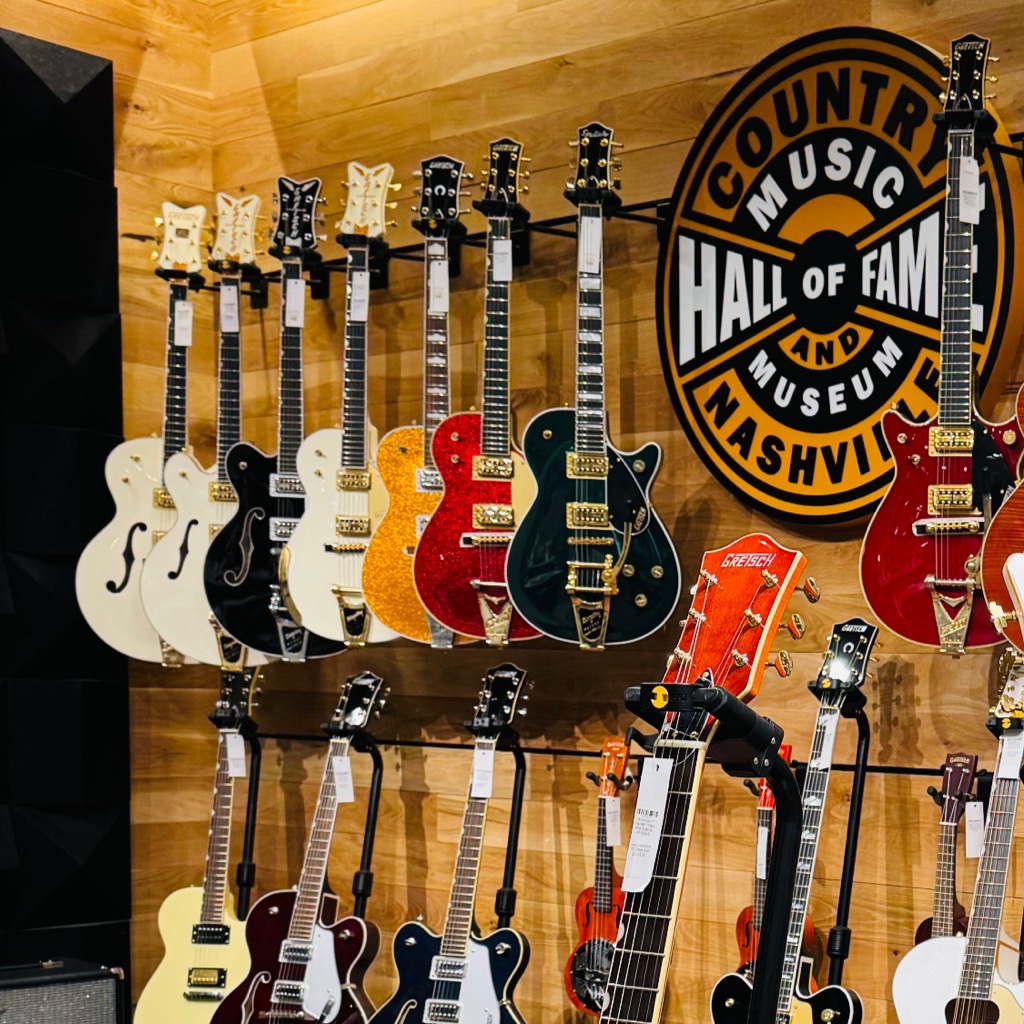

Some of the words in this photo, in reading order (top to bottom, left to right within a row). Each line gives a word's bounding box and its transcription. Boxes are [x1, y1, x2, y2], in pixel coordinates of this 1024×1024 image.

[955, 41, 985, 50] GRETSCH
[746, 137, 904, 232] MUSIC
[678, 234, 787, 366] HALL
[802, 262, 845, 300] OF
[791, 327, 861, 365] AND
[748, 336, 904, 417] MUSEUM
[720, 553, 776, 568] GRETSCH
